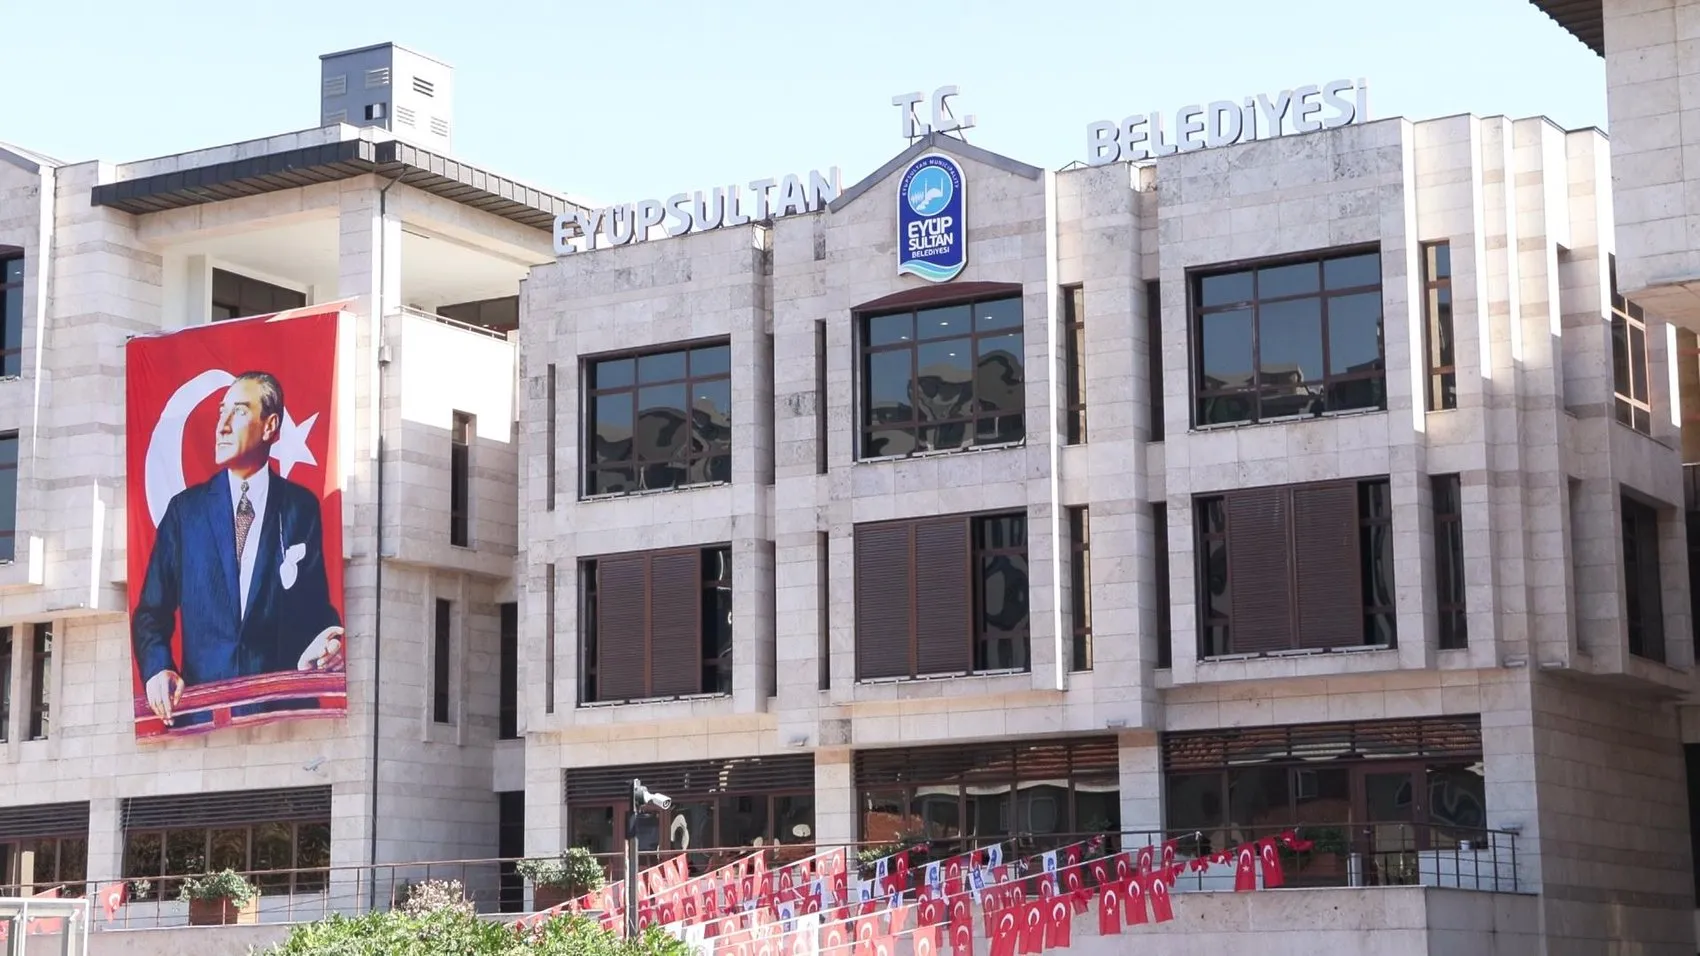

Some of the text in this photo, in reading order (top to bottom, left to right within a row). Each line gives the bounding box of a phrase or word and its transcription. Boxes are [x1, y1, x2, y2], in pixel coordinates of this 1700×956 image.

[891, 85, 976, 138] T.C.
[553, 166, 841, 255] EYÜPSULTAN
[908, 216, 953, 238] EYÜP
[908, 232, 953, 251] SULTAN
